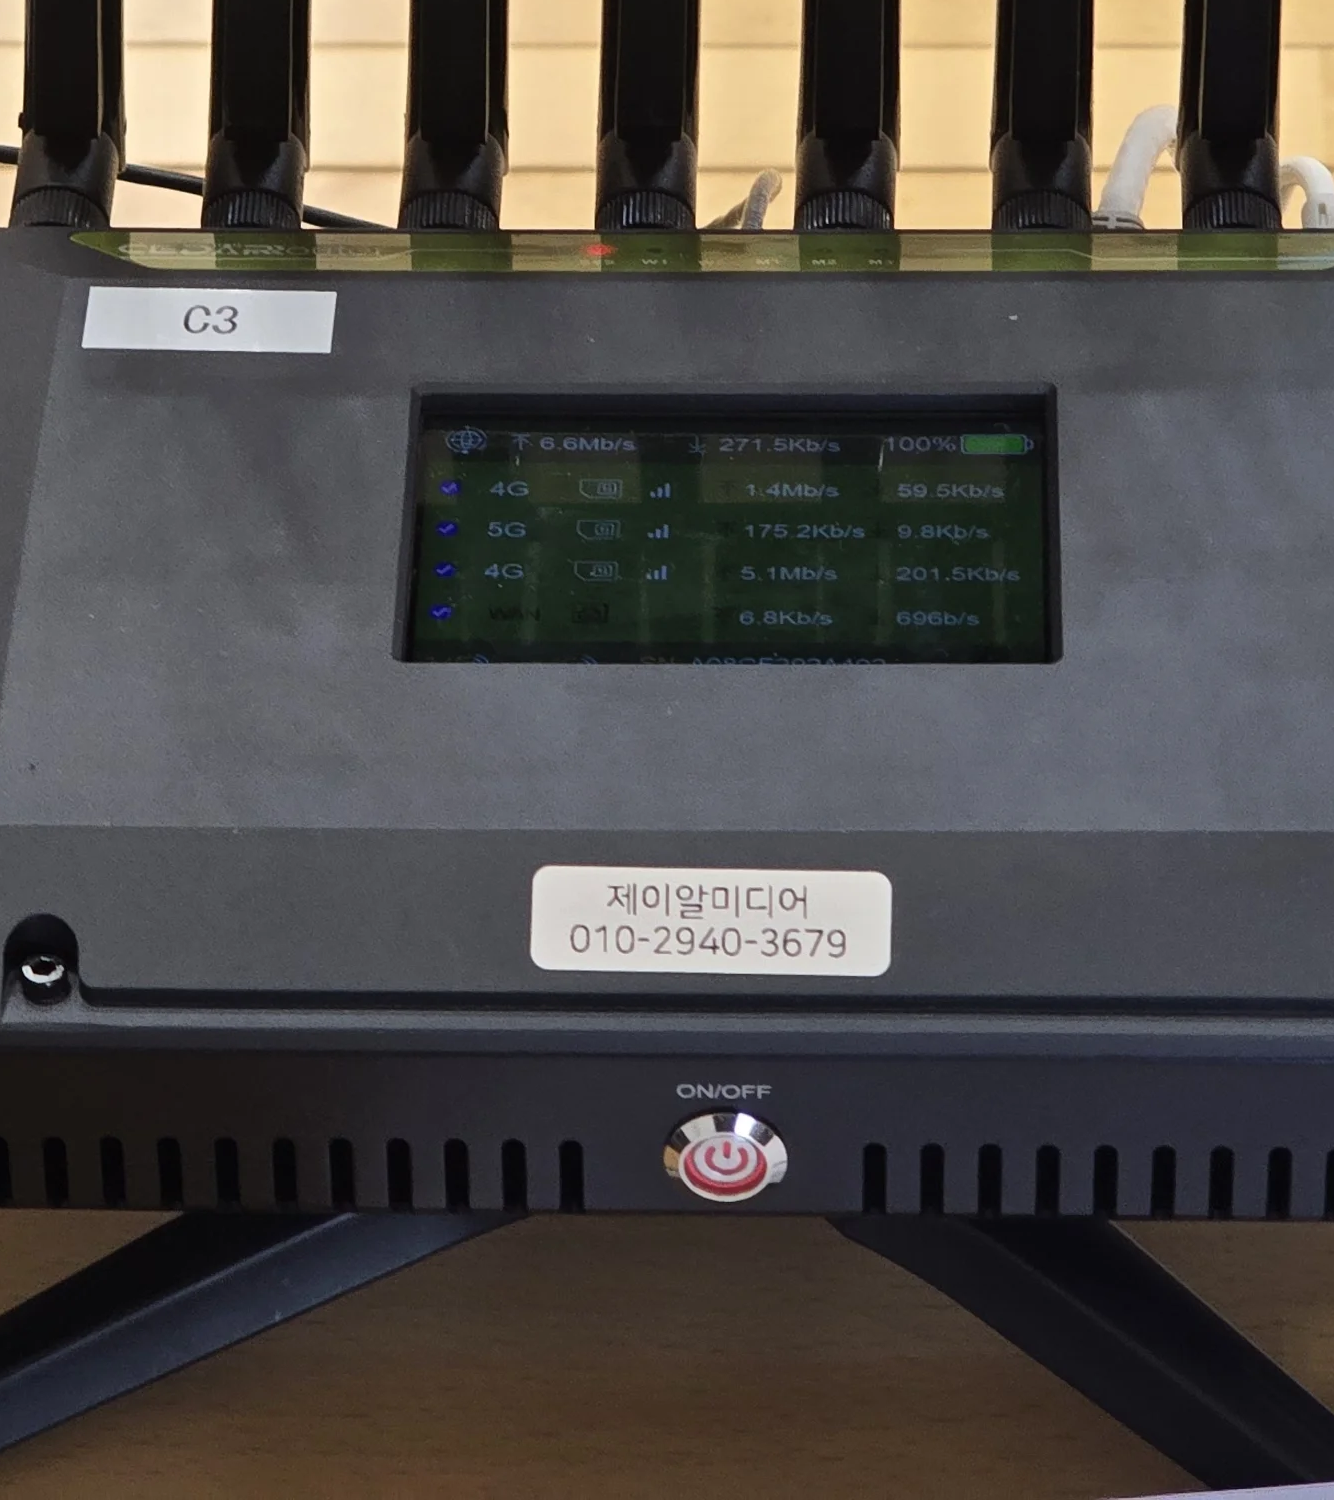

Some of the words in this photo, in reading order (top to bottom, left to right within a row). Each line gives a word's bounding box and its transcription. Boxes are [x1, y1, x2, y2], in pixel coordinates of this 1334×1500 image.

[183, 304, 239, 334] C3
[540, 437, 637, 451] 6.6Mb/s
[719, 437, 841, 452] 271.5Kb/s
[886, 437, 956, 452] 100%
[489, 481, 529, 497] 4G
[746, 483, 839, 498] 1.4Mb/s
[897, 484, 1005, 498] 59.5Kb/s
[487, 522, 527, 538] 5G
[746, 524, 865, 539] 175.2Kb/s
[897, 524, 989, 539] 9.8Kb/s
[484, 563, 524, 579] 4G
[740, 566, 838, 581] 5.1Mb/s
[896, 567, 1020, 582] 201.5Kb/s
[739, 611, 833, 626] 6.8Kb/s
[896, 611, 980, 626] 696b/s
[607, 883, 808, 920] 제이알미디어
[570, 924, 847, 958] 010-2940-3679
[675, 1083, 772, 1099] ON/OFF
